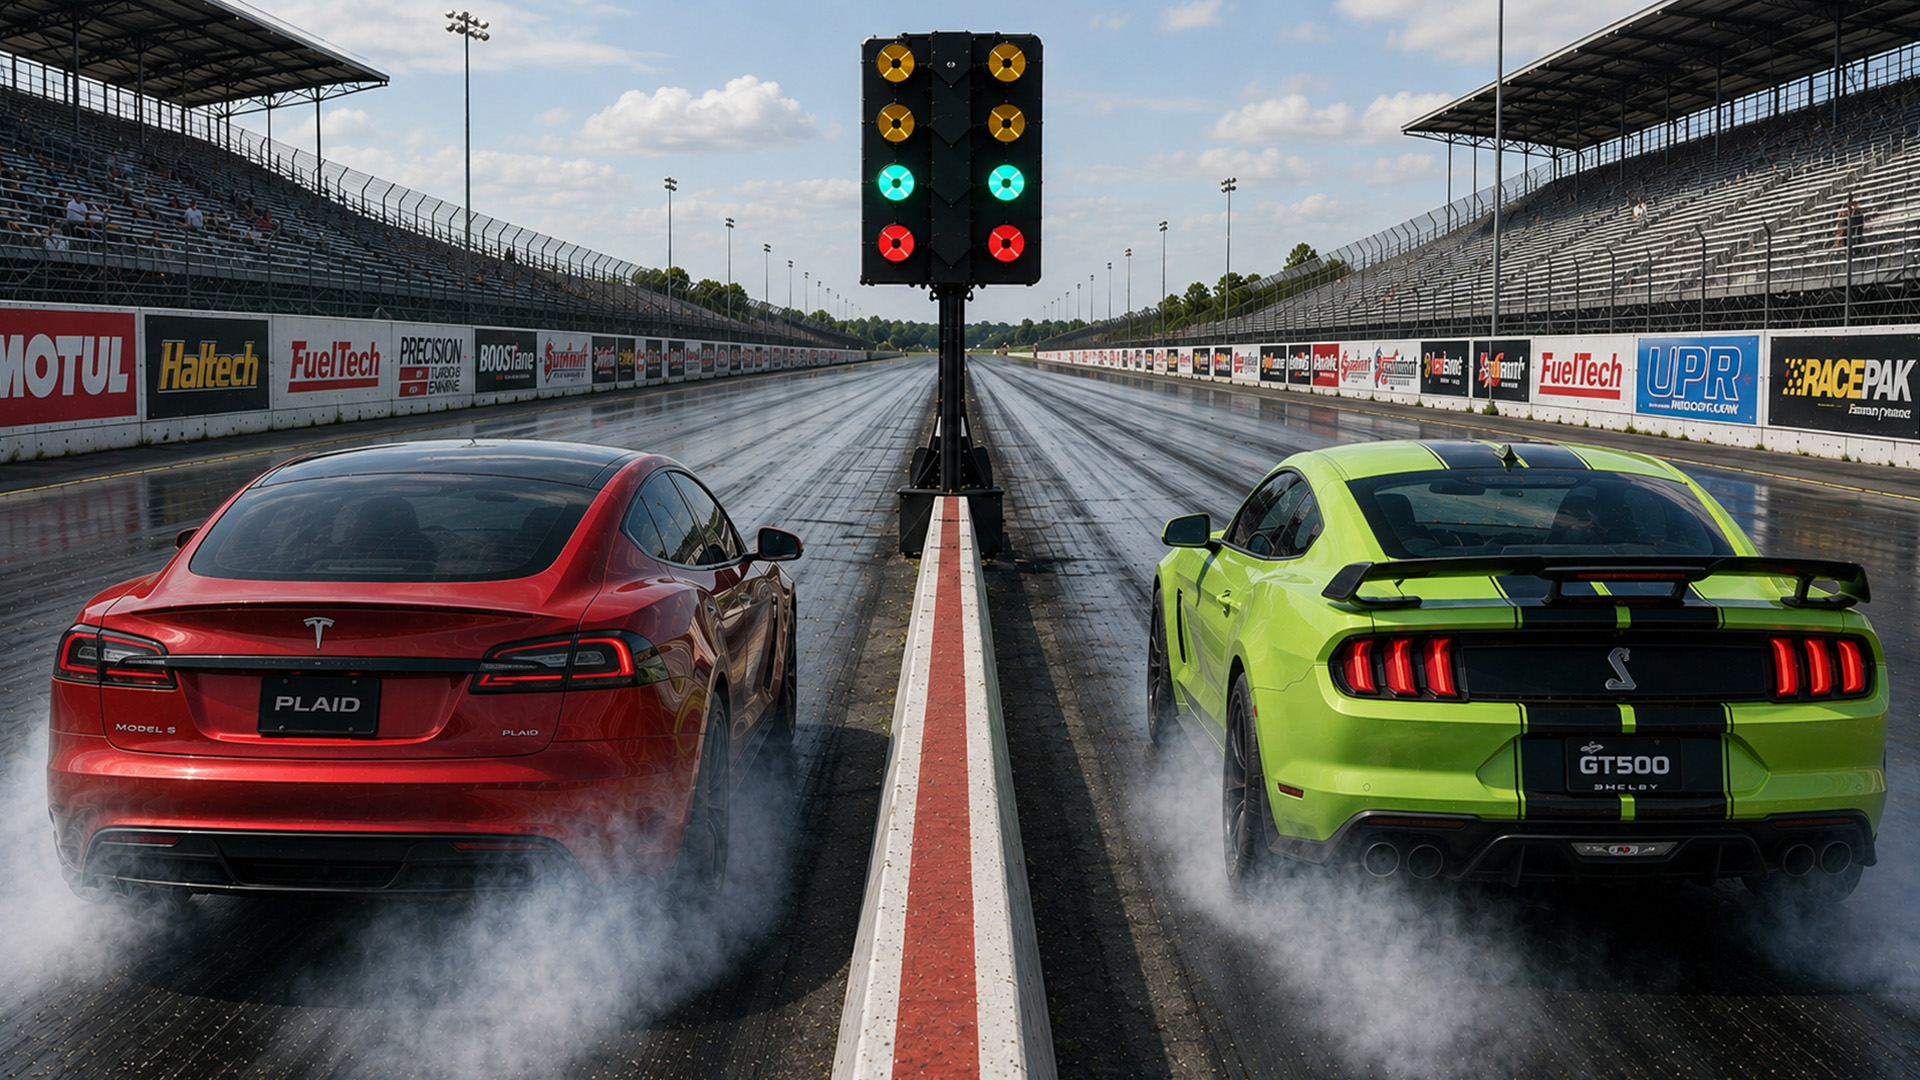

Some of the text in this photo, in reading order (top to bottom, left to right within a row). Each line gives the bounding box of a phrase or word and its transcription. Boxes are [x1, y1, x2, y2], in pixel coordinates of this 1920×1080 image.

[0, 333, 129, 399] MOTUL
[157, 339, 259, 394] Haltech
[289, 340, 381, 380] FuelTech
[400, 336, 463, 365] PRECISION
[1540, 352, 1623, 388] FuelTech
[1647, 346, 1740, 402] UPR
[1801, 358, 1917, 402] RACEPAK
[274, 696, 361, 713] PLAID
[115, 723, 177, 735] MODEL S
[502, 729, 539, 737] PLAID
[1579, 755, 1670, 775] GT500
[1593, 783, 1658, 791] SHELBY
